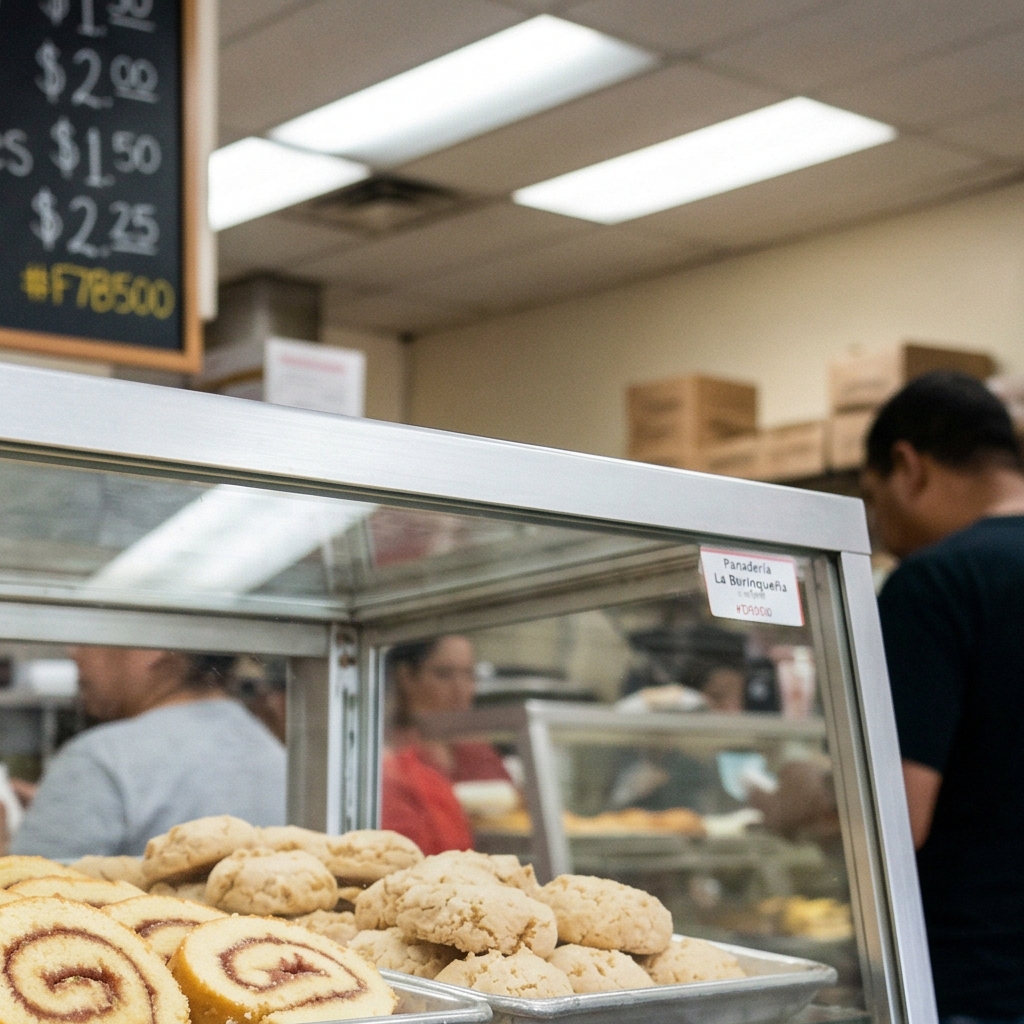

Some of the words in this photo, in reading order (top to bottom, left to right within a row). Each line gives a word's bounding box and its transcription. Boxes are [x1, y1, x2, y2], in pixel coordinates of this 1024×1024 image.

[35, 38, 160, 107] $2.00
[50, 115, 162, 188] $1.50
[29, 186, 160, 257] $2.25
[714, 572, 726, 585] La
